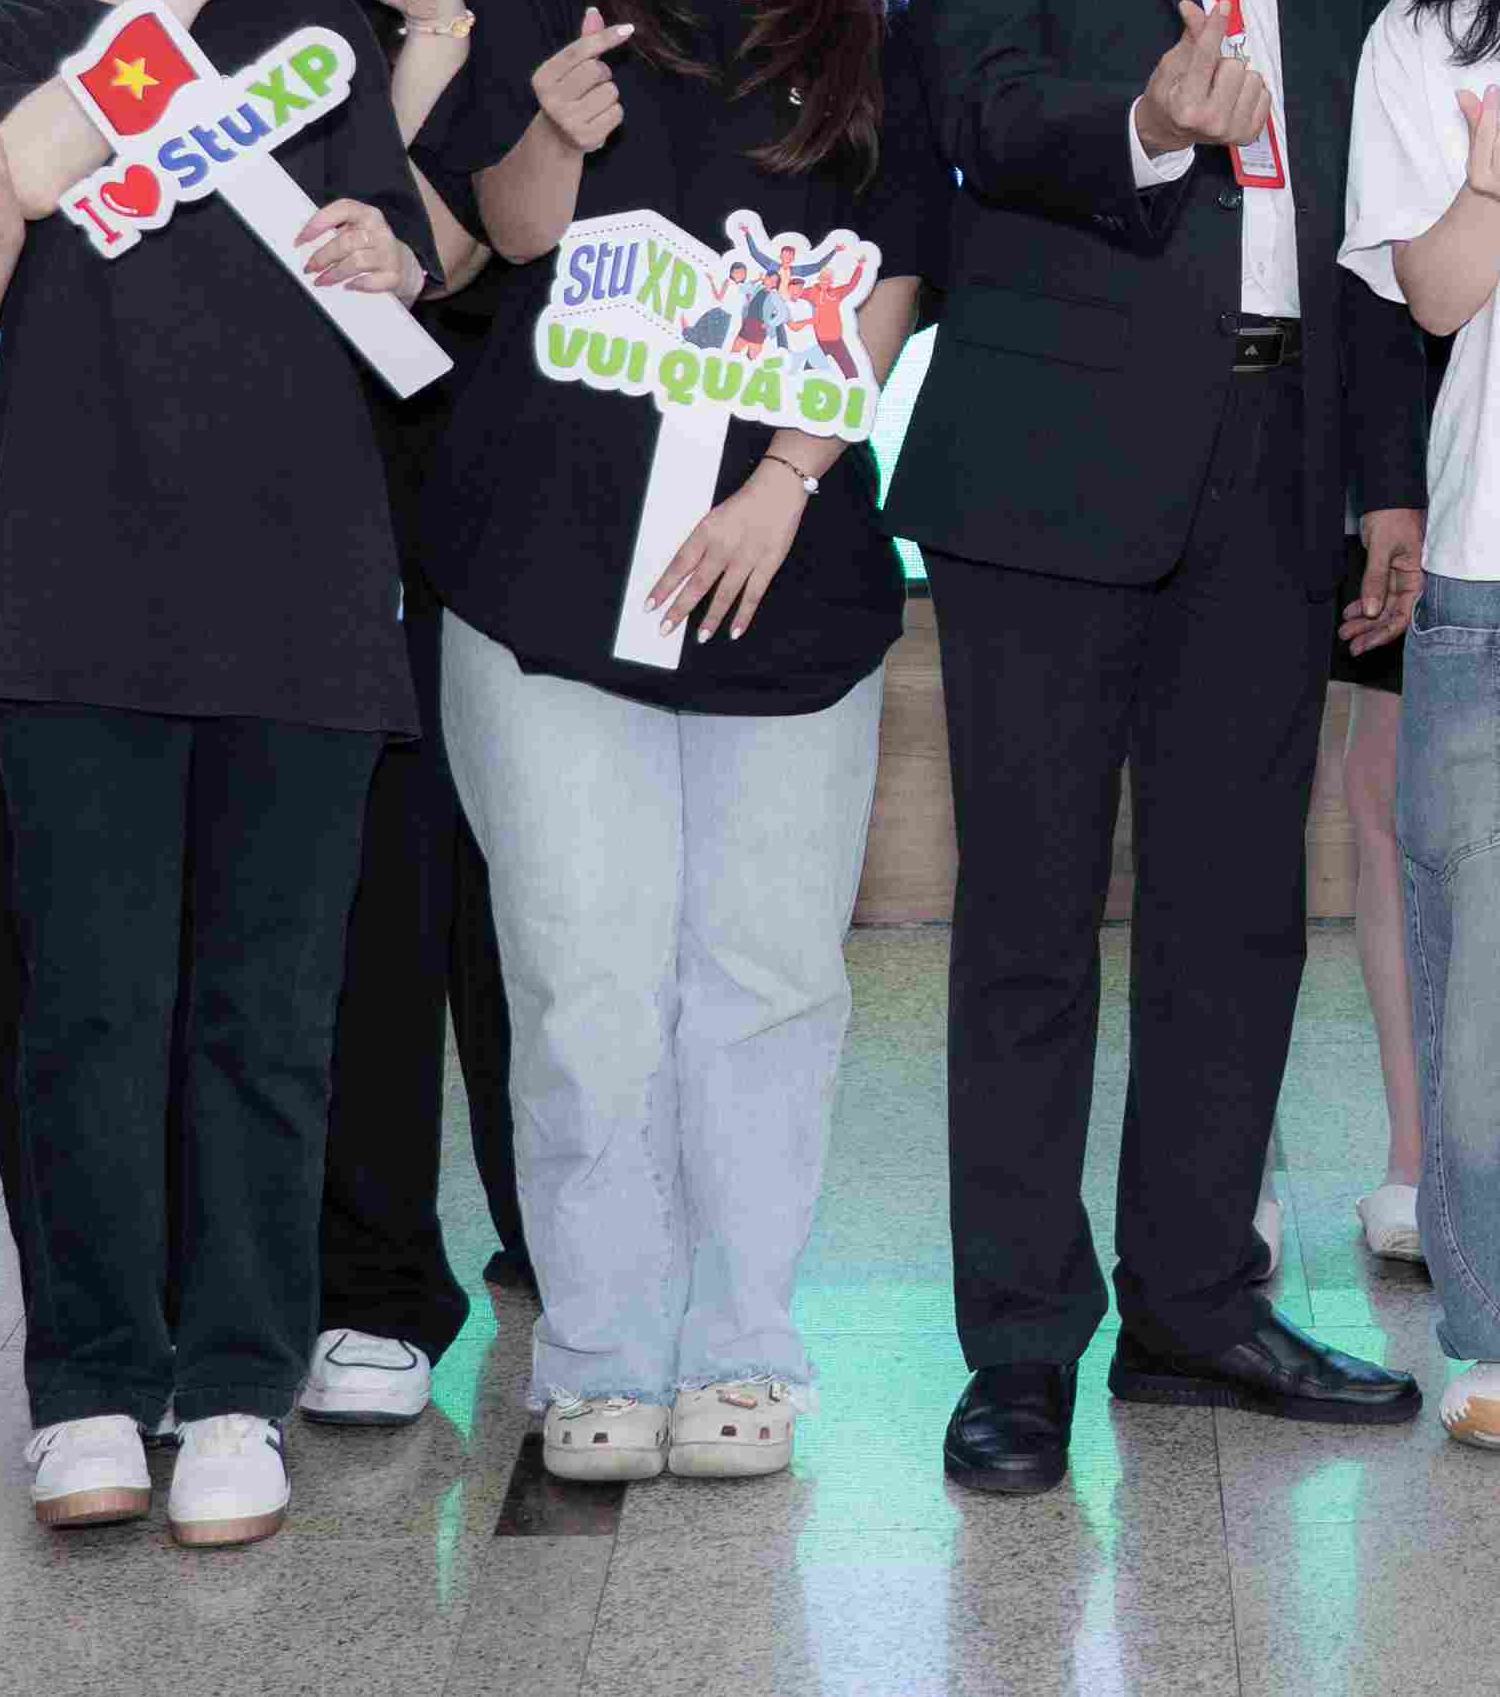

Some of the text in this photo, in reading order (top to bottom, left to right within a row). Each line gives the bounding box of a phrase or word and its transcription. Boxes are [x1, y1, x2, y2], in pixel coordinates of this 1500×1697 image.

[73, 196, 124, 245] I
[547, 322, 867, 429] VUI QUÁ ĐI
